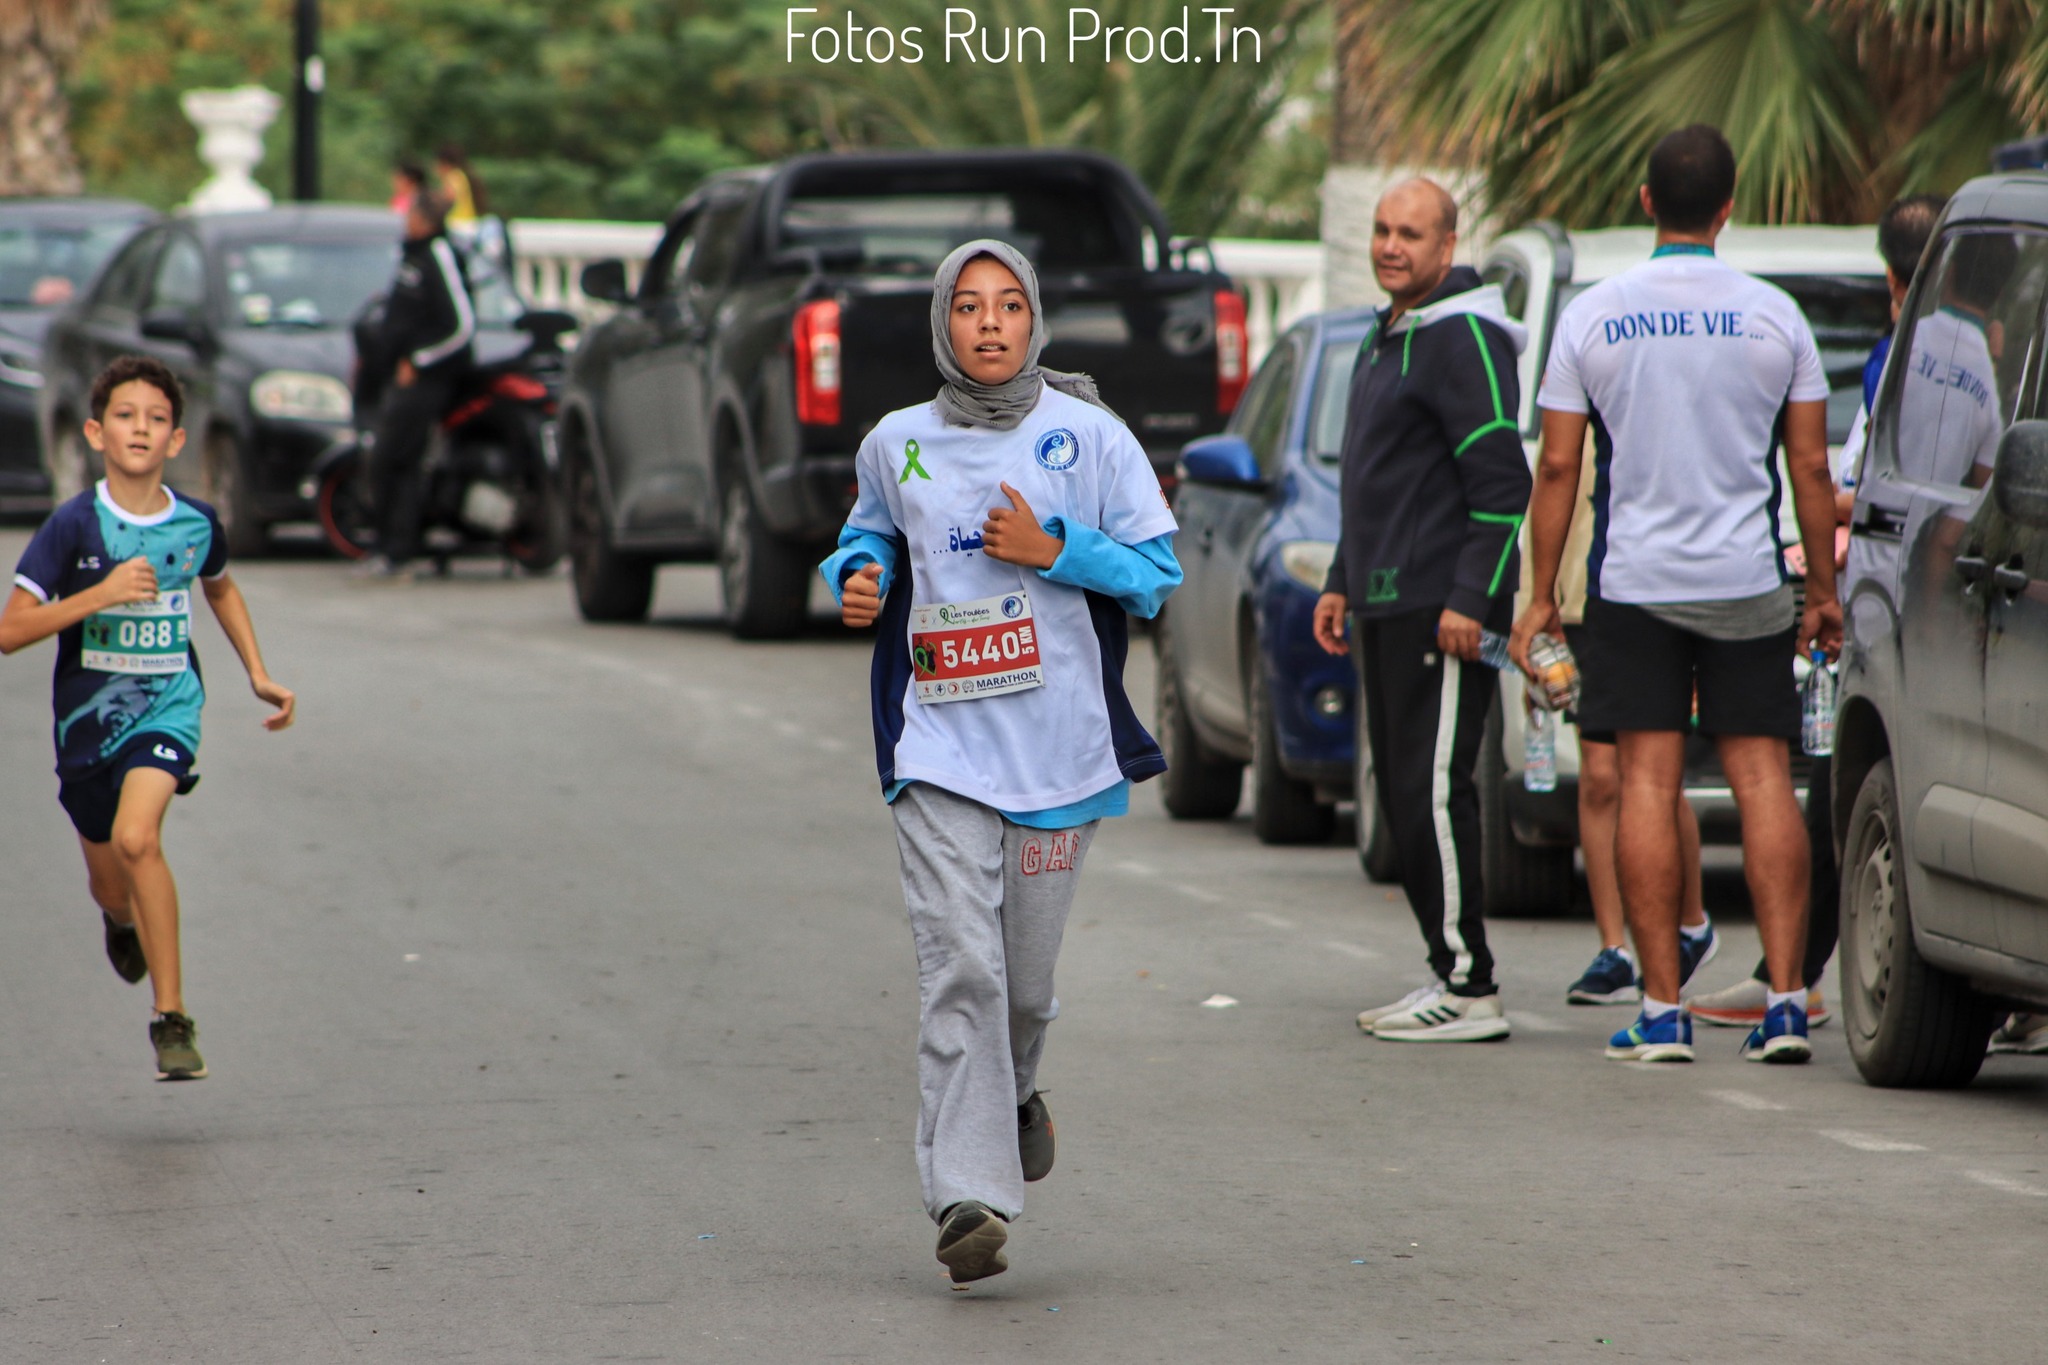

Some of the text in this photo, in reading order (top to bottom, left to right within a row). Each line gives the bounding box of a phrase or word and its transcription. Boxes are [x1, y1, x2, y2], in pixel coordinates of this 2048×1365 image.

[1604, 311, 1656, 345] DON
[1661, 311, 1695, 337] DE
[119, 620, 172, 648] 088
[1018, 625, 1036, 655] 5 KM
[942, 631, 1020, 668] 5440
[976, 670, 1037, 688] MARATHON
[152, 743, 179, 761] LS
